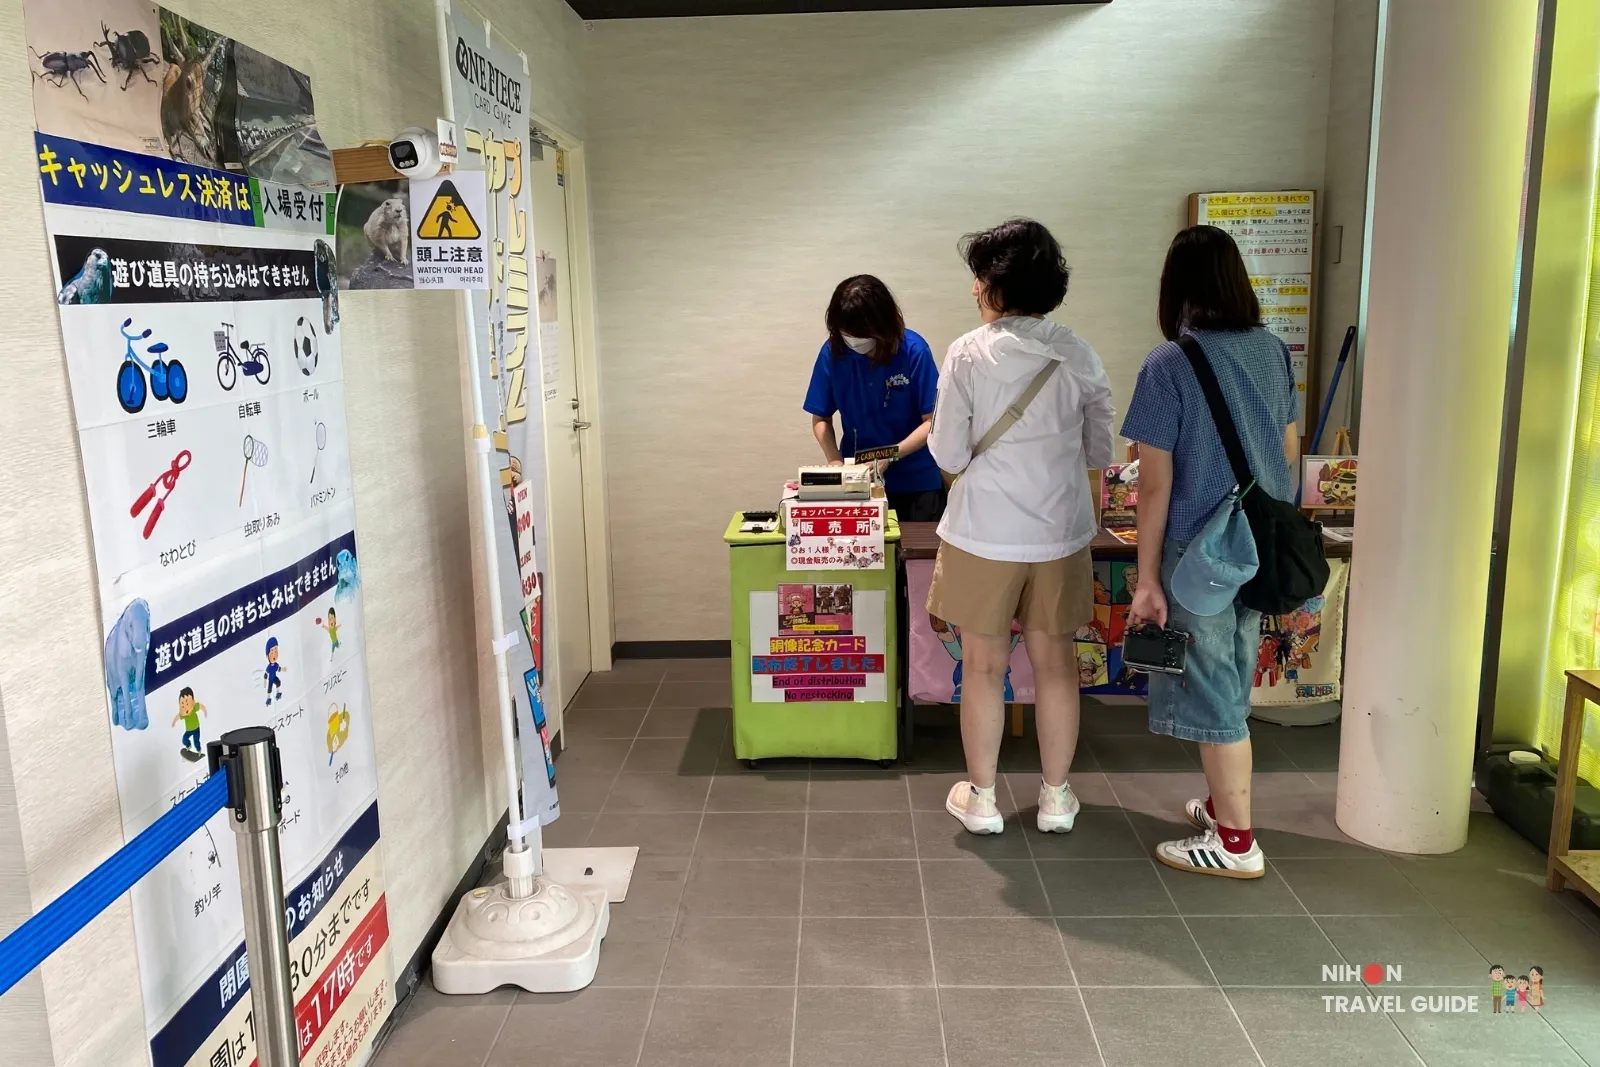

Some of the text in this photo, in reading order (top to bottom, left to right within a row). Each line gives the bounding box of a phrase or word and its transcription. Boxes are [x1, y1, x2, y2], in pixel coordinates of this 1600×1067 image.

[456, 37, 521, 114] ONE PIECE
[473, 93, 490, 115] CARD
[39, 143, 251, 211] キャッシュレス決済は
[263, 187, 324, 222] 入場受付
[416, 246, 483, 262] 頭上注意
[110, 257, 310, 289] 遊び道具の持ち込みはできません
[417, 266, 484, 274] WATCH YOUR HEAD
[303, 388, 319, 403] ボール
[238, 401, 262, 419] 自転車
[147, 418, 177, 439] 三輪車
[791, 507, 879, 517] チョッパーフィギュア
[244, 512, 281, 537] 虫取りあみ
[159, 539, 197, 567] なわとび
[154, 556, 337, 674] 遊び道具の持ち込みはできません
[770, 638, 865, 653] 銅像記念カード
[752, 656, 883, 673] 配布終了しました。
[772, 676, 791, 687] End
[794, 676, 804, 685] of
[785, 691, 797, 700] No
[334, 762, 349, 784] その他
[194, 883, 222, 918] 釣り竿
[295, 933, 374, 1058] は17時です
